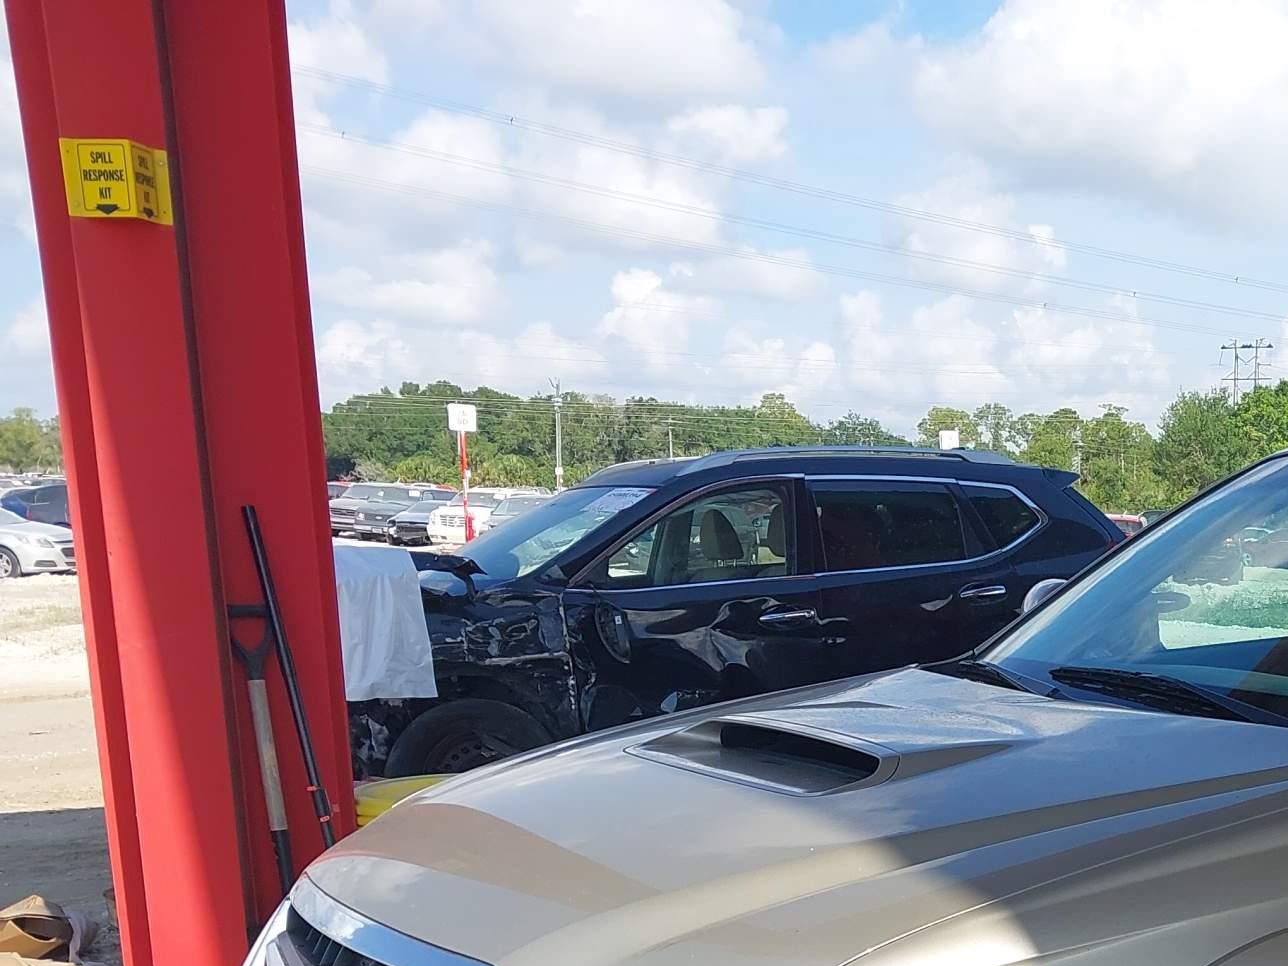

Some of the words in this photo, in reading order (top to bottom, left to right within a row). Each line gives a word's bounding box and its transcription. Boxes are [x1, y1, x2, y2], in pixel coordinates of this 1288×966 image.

[90, 152, 113, 164] SPILL
[83, 169, 125, 181] RESPONSE
[99, 187, 111, 199] KIT
